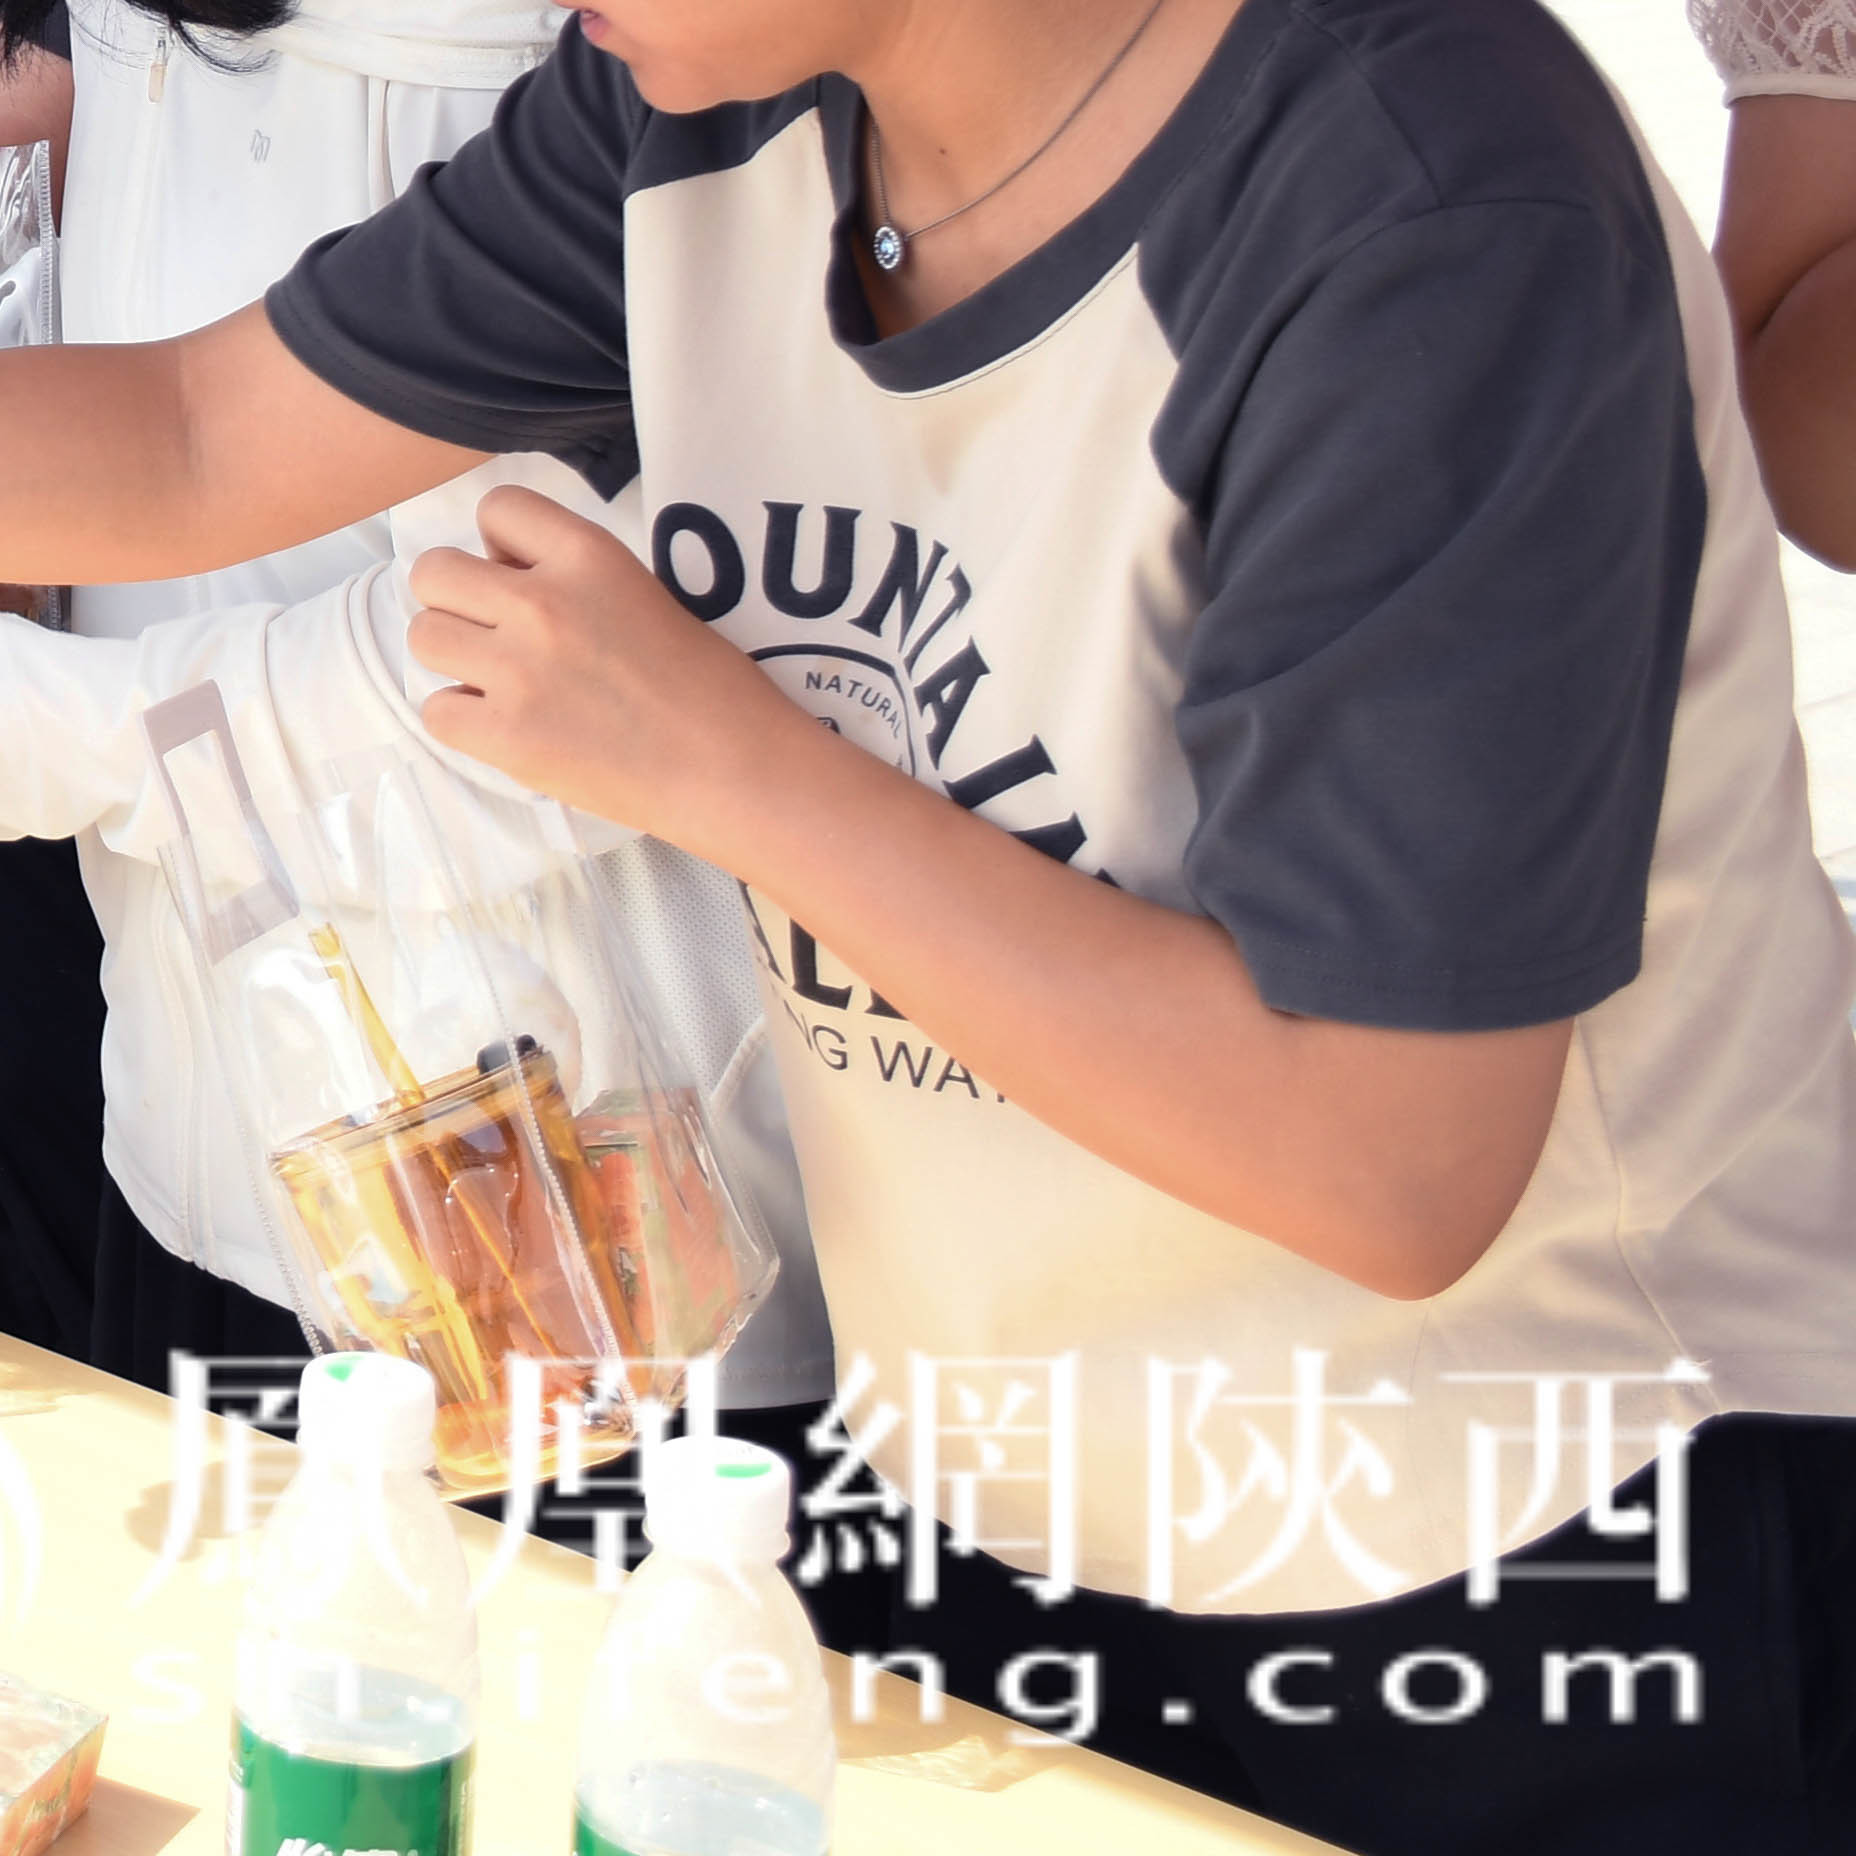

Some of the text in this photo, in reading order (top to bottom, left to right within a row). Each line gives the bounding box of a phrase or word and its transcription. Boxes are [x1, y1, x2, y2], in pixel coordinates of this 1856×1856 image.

[651, 500, 1122, 889] OUNTAI
[805, 670, 905, 740] NATURAL
[870, 1035, 1006, 1104] WA
